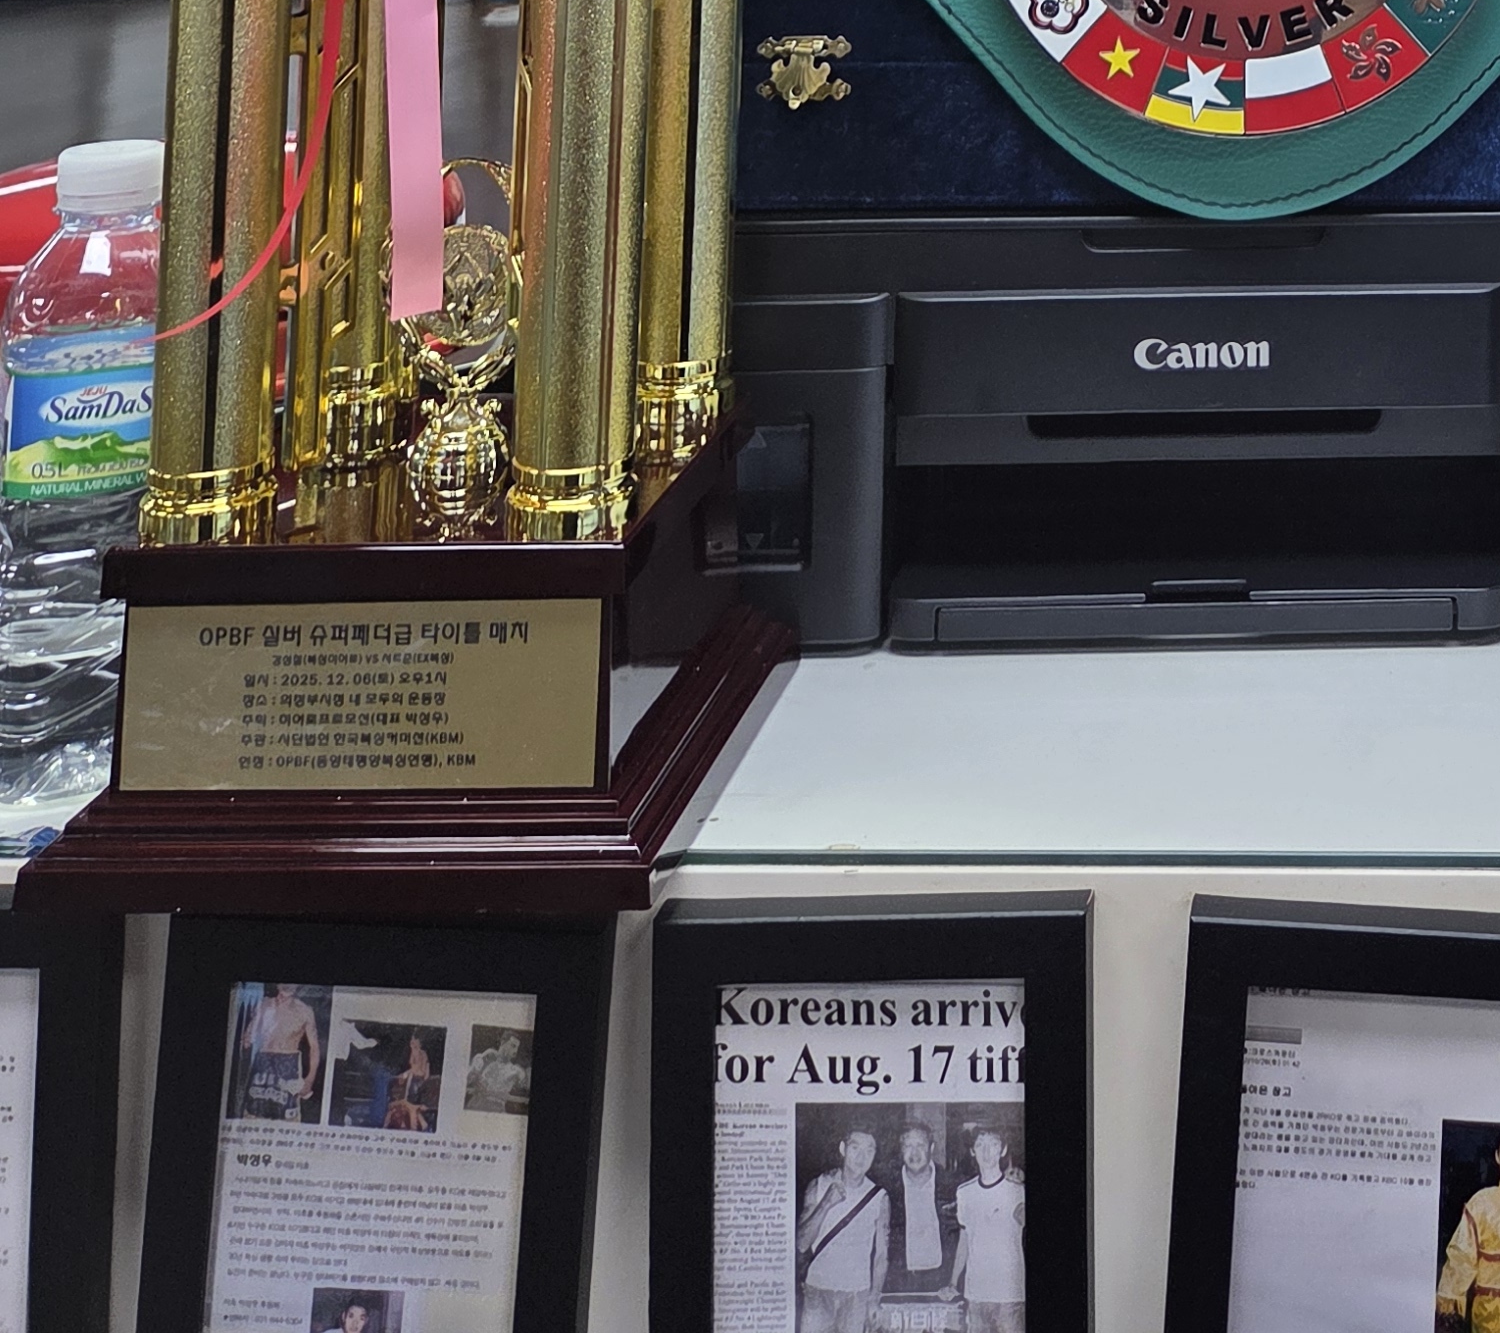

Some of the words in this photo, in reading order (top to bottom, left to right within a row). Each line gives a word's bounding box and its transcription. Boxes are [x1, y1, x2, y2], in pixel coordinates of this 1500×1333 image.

[1133, 337, 1270, 370] Canon
[79, 385, 108, 397] JEJU
[198, 625, 255, 647] OPBF
[261, 624, 303, 648] 실버
[309, 623, 412, 646] 슈퍼페더급
[420, 622, 482, 645] 타이틀
[488, 621, 529, 645] 매치
[446, 753, 477, 767] KBM
[715, 988, 898, 1027] Koreans
[714, 1042, 775, 1084] for
[786, 1042, 893, 1096] Aug.
[906, 1044, 955, 1084] 17
